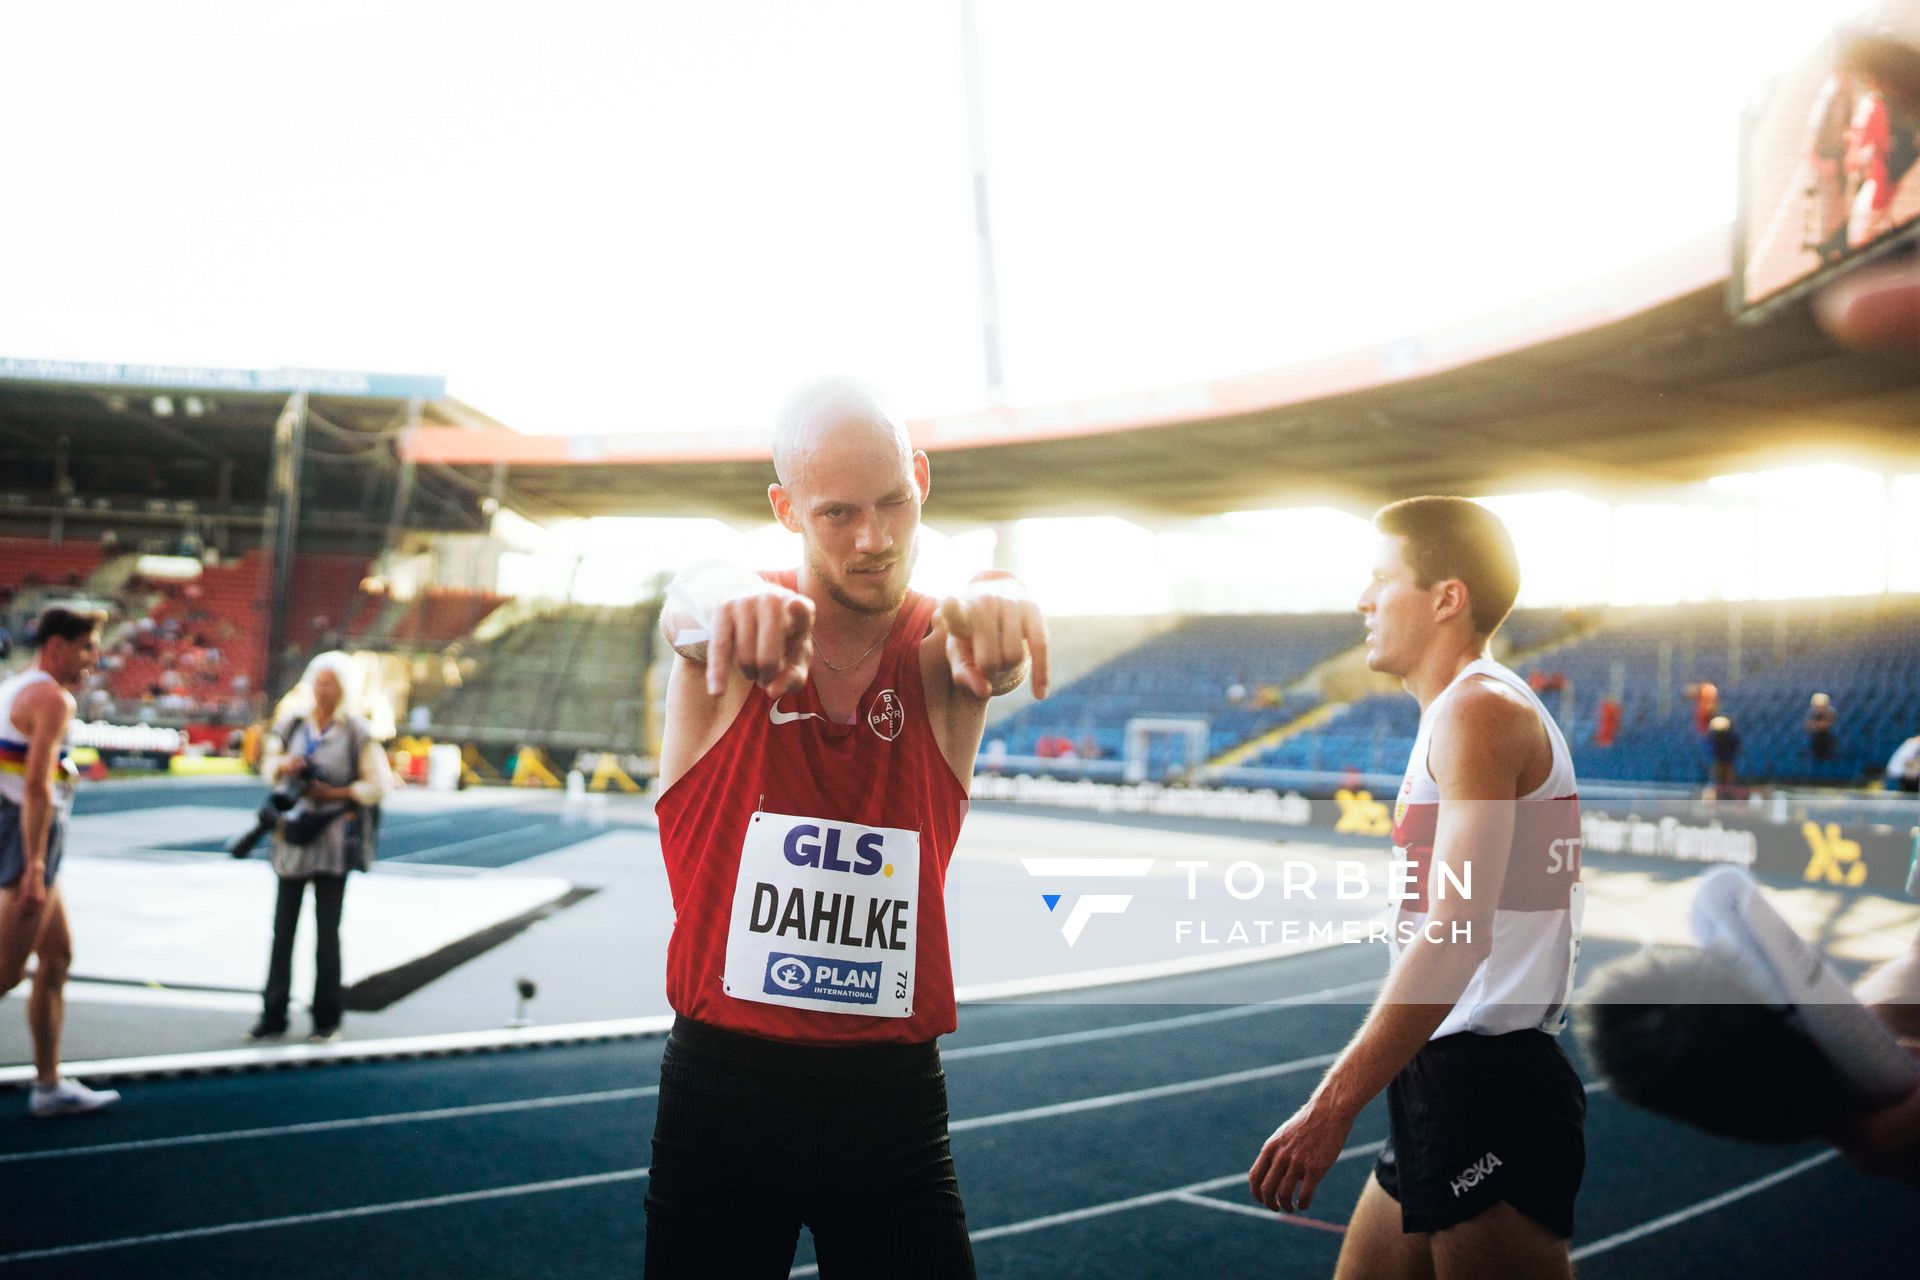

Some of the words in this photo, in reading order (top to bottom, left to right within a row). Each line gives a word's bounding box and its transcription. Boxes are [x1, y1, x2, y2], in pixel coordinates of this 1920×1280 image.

[1546, 837, 1582, 874] ST
[749, 882, 909, 951] DAHLKE
[814, 987, 874, 999] INTERNATIONAL
[815, 966, 877, 989] PLAN
[895, 971, 908, 999] 773
[1450, 1152, 1503, 1198] HOKA
